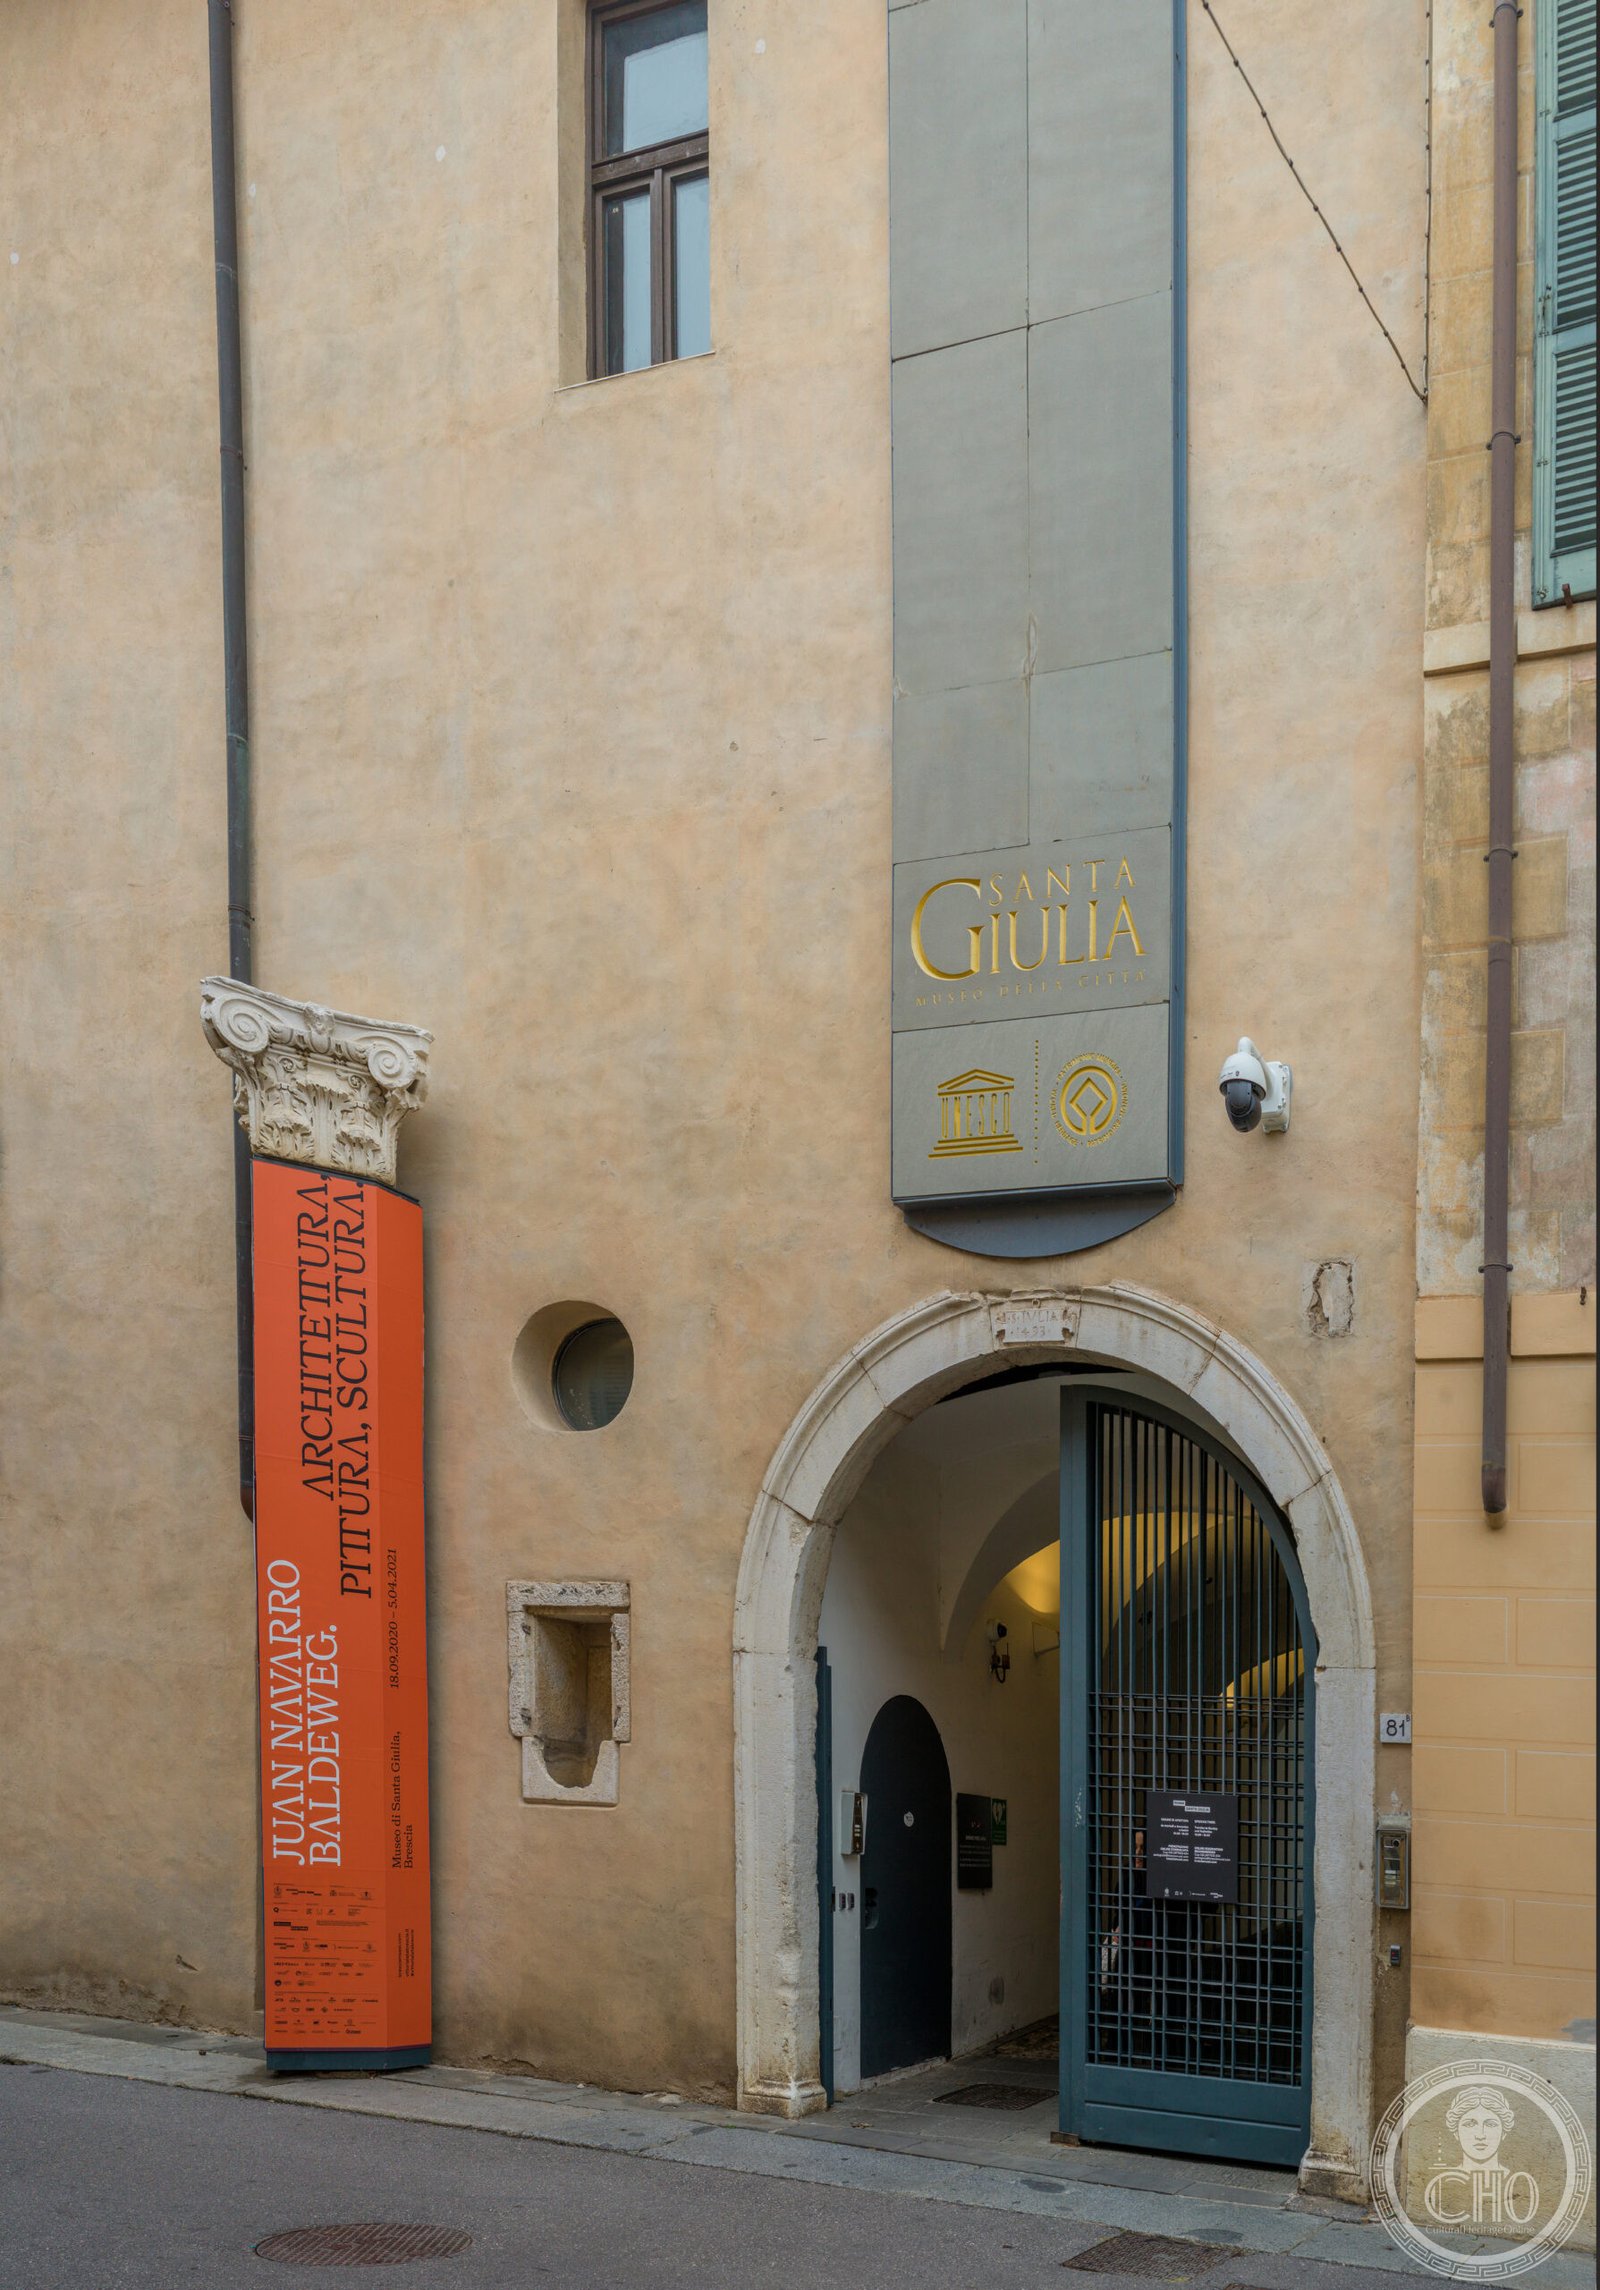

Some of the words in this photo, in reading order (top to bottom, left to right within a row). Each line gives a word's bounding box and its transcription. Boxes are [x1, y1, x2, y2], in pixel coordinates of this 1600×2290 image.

[989, 856, 1136, 906] SANTA
[911, 878, 1147, 981] GIULIA
[915, 990, 984, 1007] MUSEO
[1001, 981, 1063, 997] DELLA
[941, 1091, 1010, 1138] UNESCO
[296, 1174, 334, 1501] ARCHITETTURA,
[337, 1422, 372, 1599] PITTURA,
[387, 1548, 398, 1609] 5.04.2021
[267, 1559, 303, 1751] NAVARRO
[388, 1621, 399, 1689] 18.09.2020
[306, 1624, 341, 1866] BALDEWEG.
[390, 1731, 402, 1773] Giulia,
[271, 1760, 305, 1866] JUAN
[391, 1775, 401, 1811] Santa
[391, 1814, 401, 1828] di
[391, 1829, 402, 1868] Museo
[403, 1824, 414, 1868] Brescia
